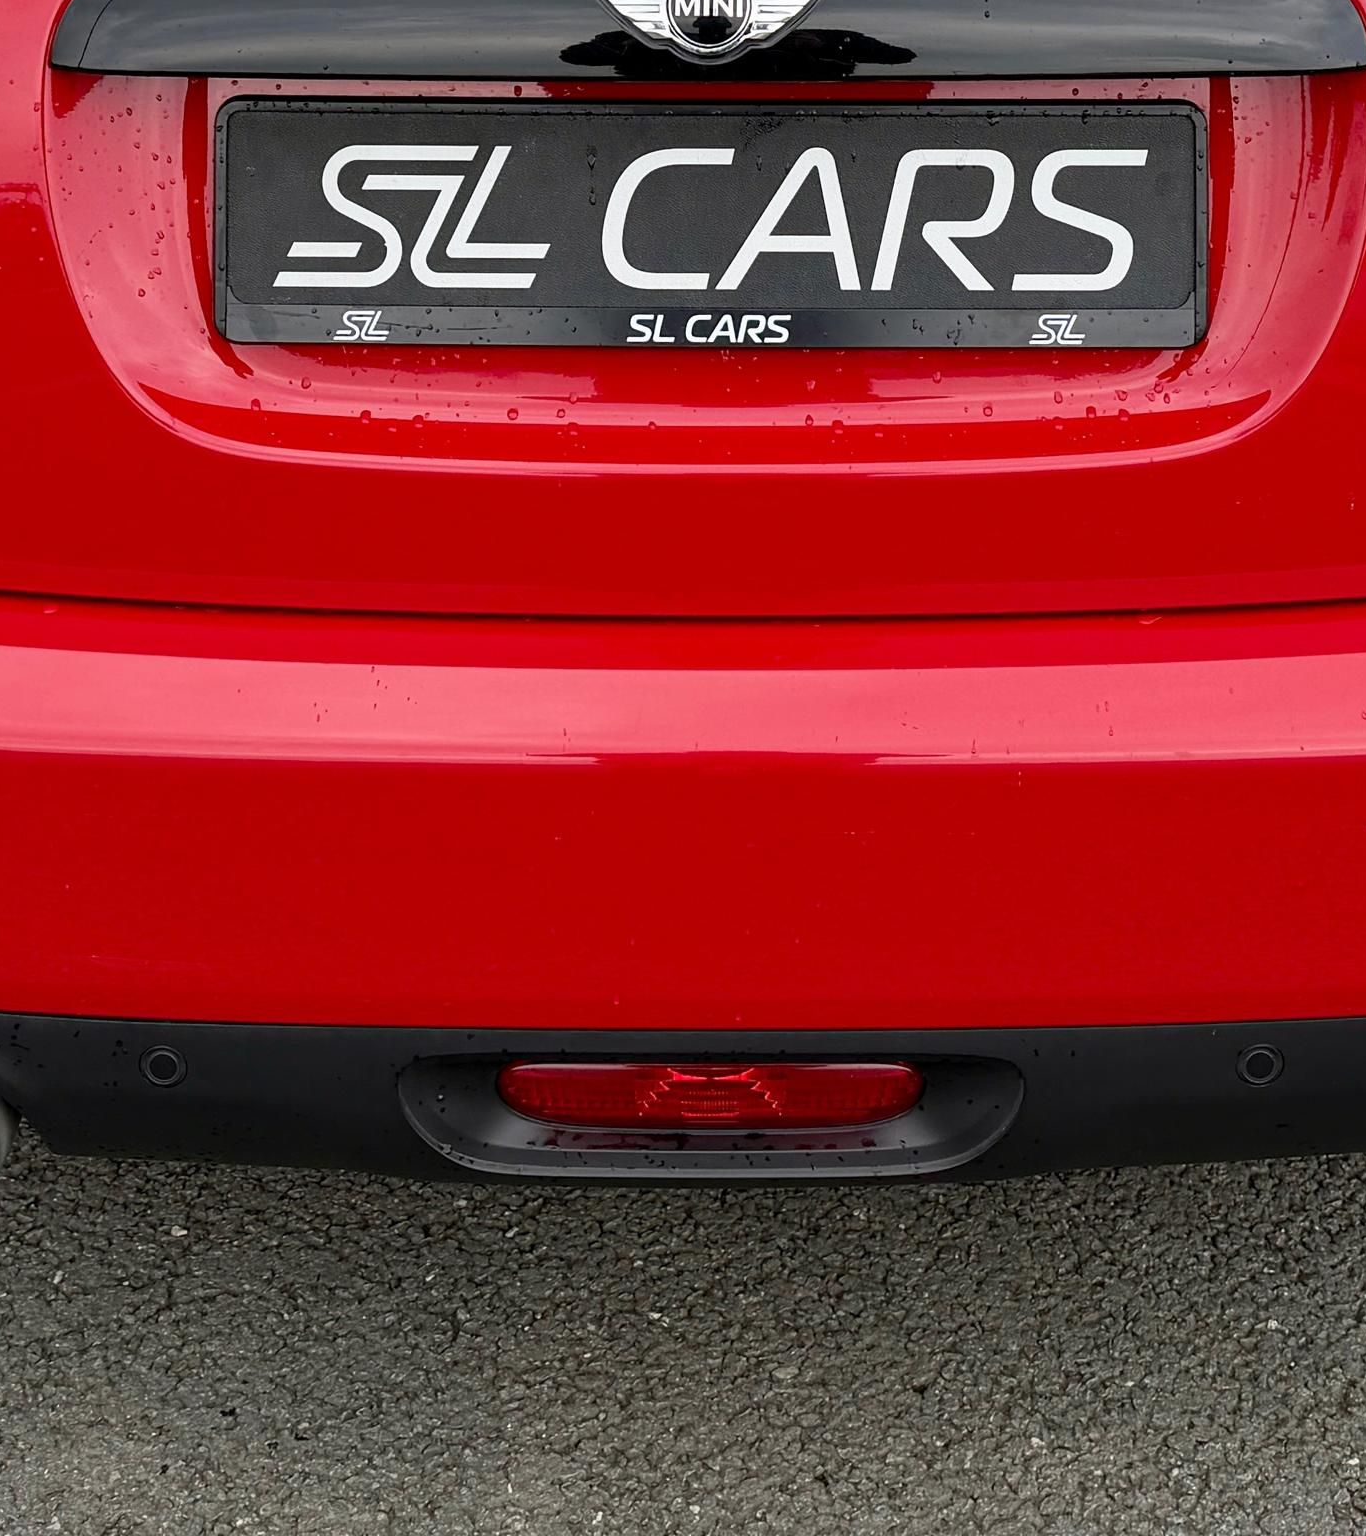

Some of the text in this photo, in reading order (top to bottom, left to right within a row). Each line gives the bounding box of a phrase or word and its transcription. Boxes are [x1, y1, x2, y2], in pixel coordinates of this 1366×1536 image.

[272, 144, 1149, 292] SL CARS
[332, 310, 390, 342] SL
[626, 314, 792, 344] SL CARS
[1028, 313, 1086, 345] SL
